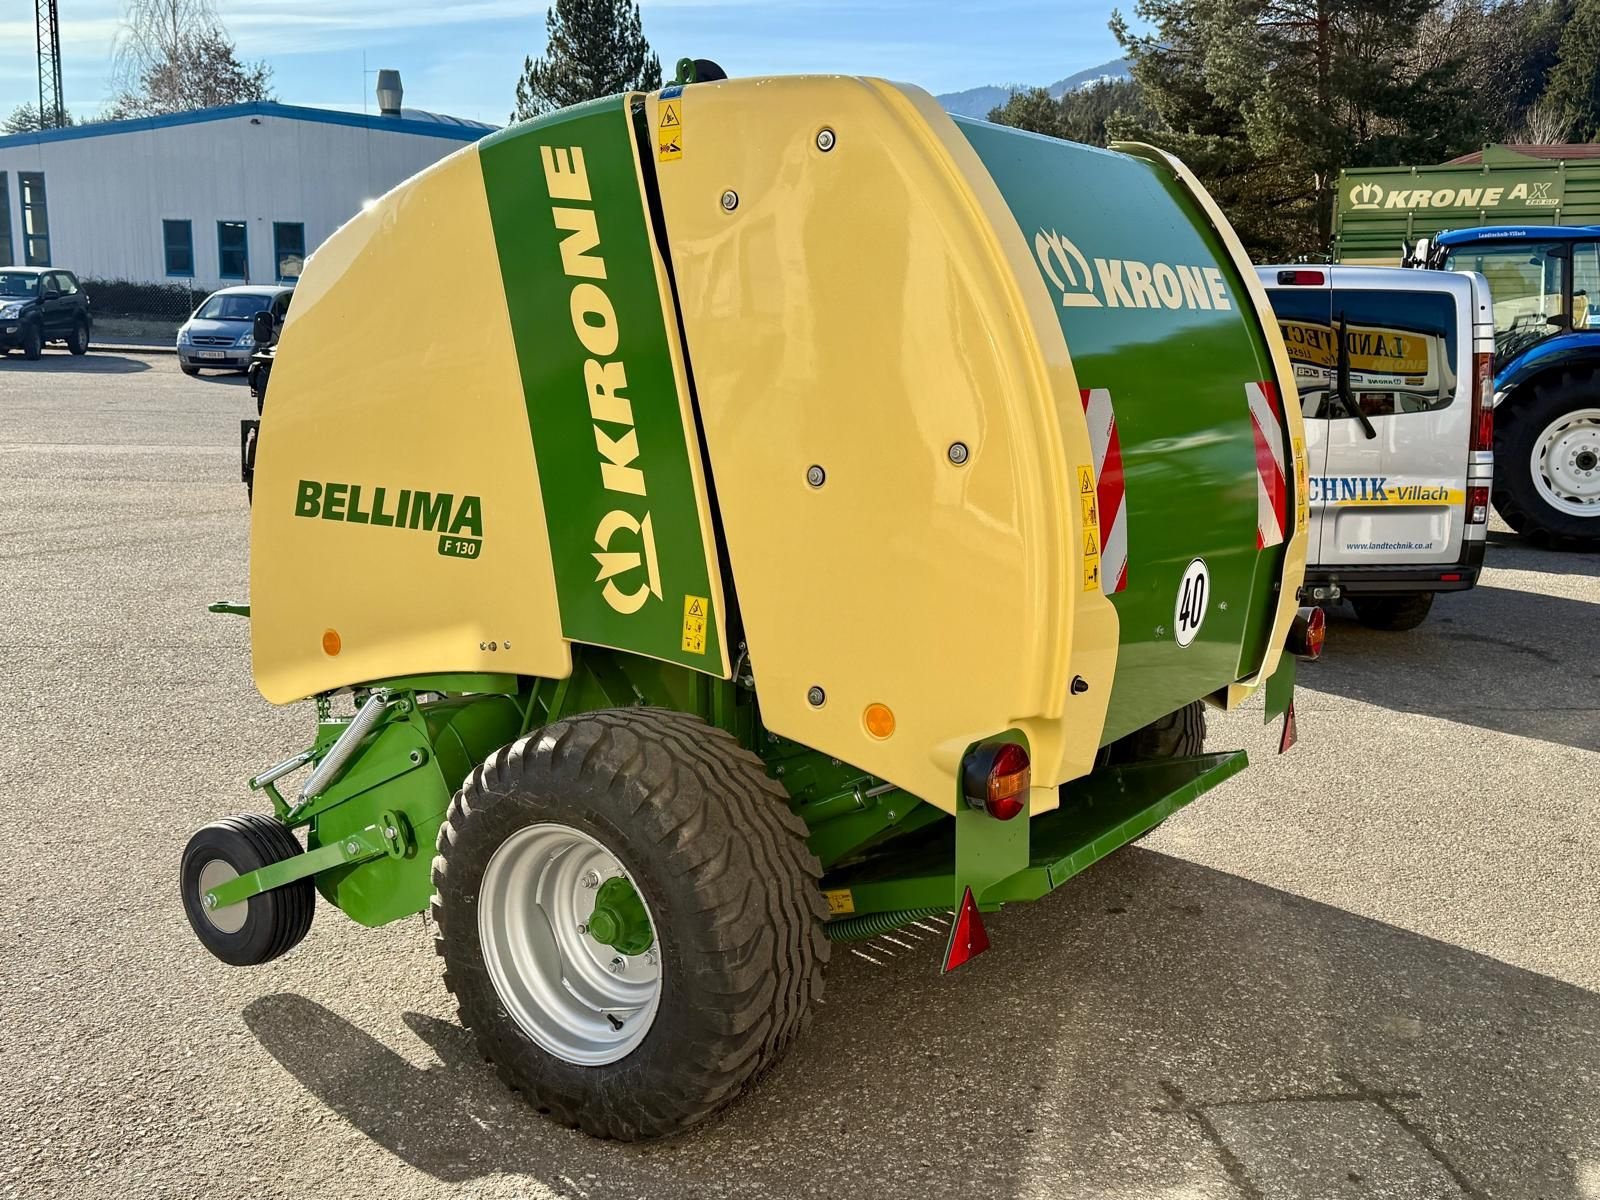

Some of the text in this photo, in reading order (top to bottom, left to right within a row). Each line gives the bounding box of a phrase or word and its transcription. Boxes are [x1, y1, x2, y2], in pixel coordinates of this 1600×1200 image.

[1384, 182, 1552, 209] KRONE AX
[1094, 258, 1231, 310] KRONE
[540, 146, 647, 497] KRONE
[295, 480, 483, 537] BELLIMA
[444, 540, 475, 555] F 130
[1346, 542, 1432, 550] www.landtechnik.co.at
[1179, 573, 1204, 631] 40
